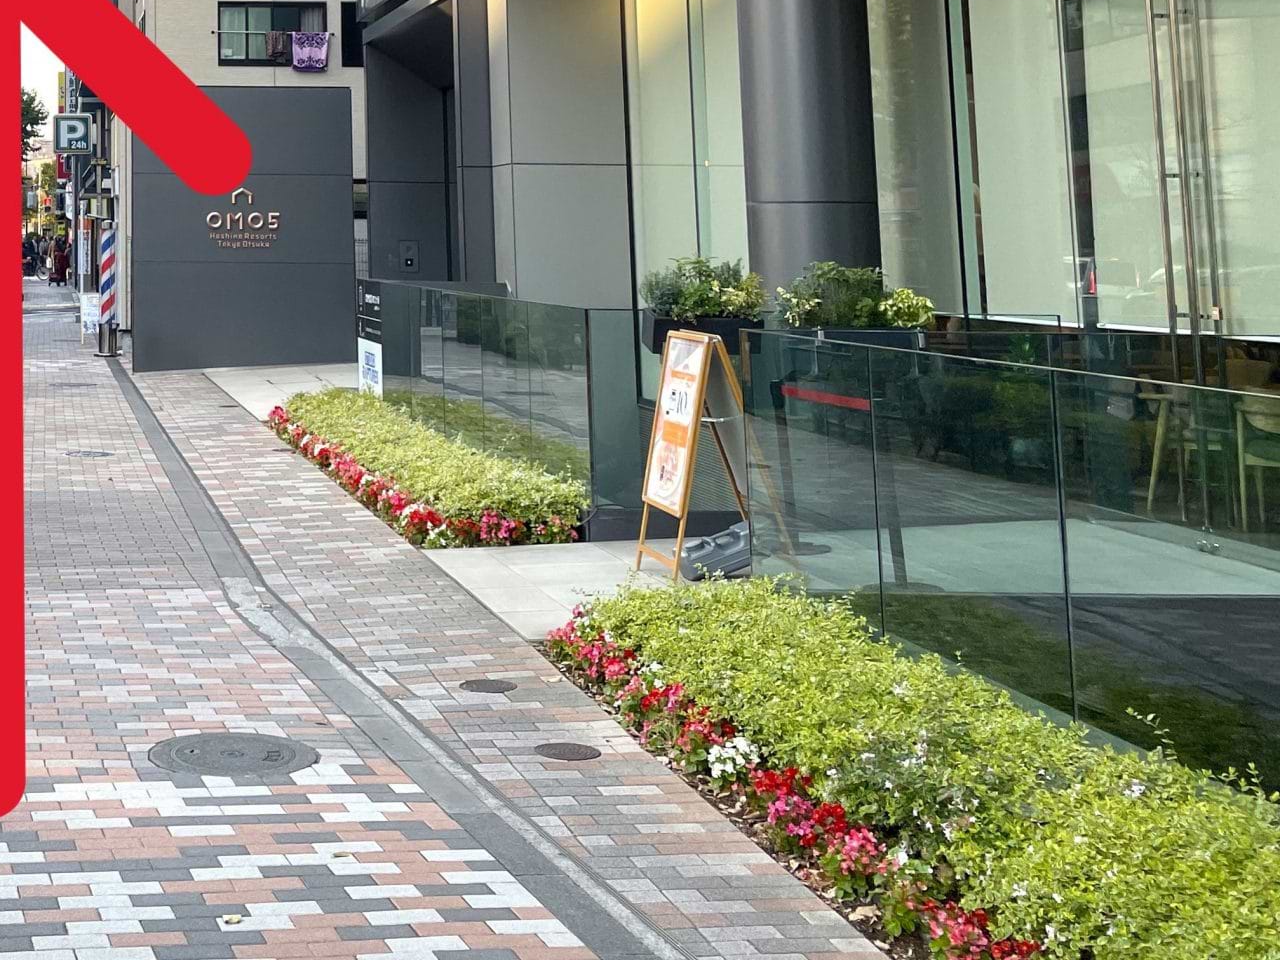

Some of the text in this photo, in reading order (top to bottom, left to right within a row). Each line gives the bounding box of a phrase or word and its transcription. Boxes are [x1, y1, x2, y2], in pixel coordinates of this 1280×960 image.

[60, 120, 85, 148] P
[71, 140, 87, 149] 24h
[206, 211, 281, 230] OMO5
[209, 232, 277, 240] Hoshino Resorts
[217, 240, 270, 248] Tokyo Otsuka
